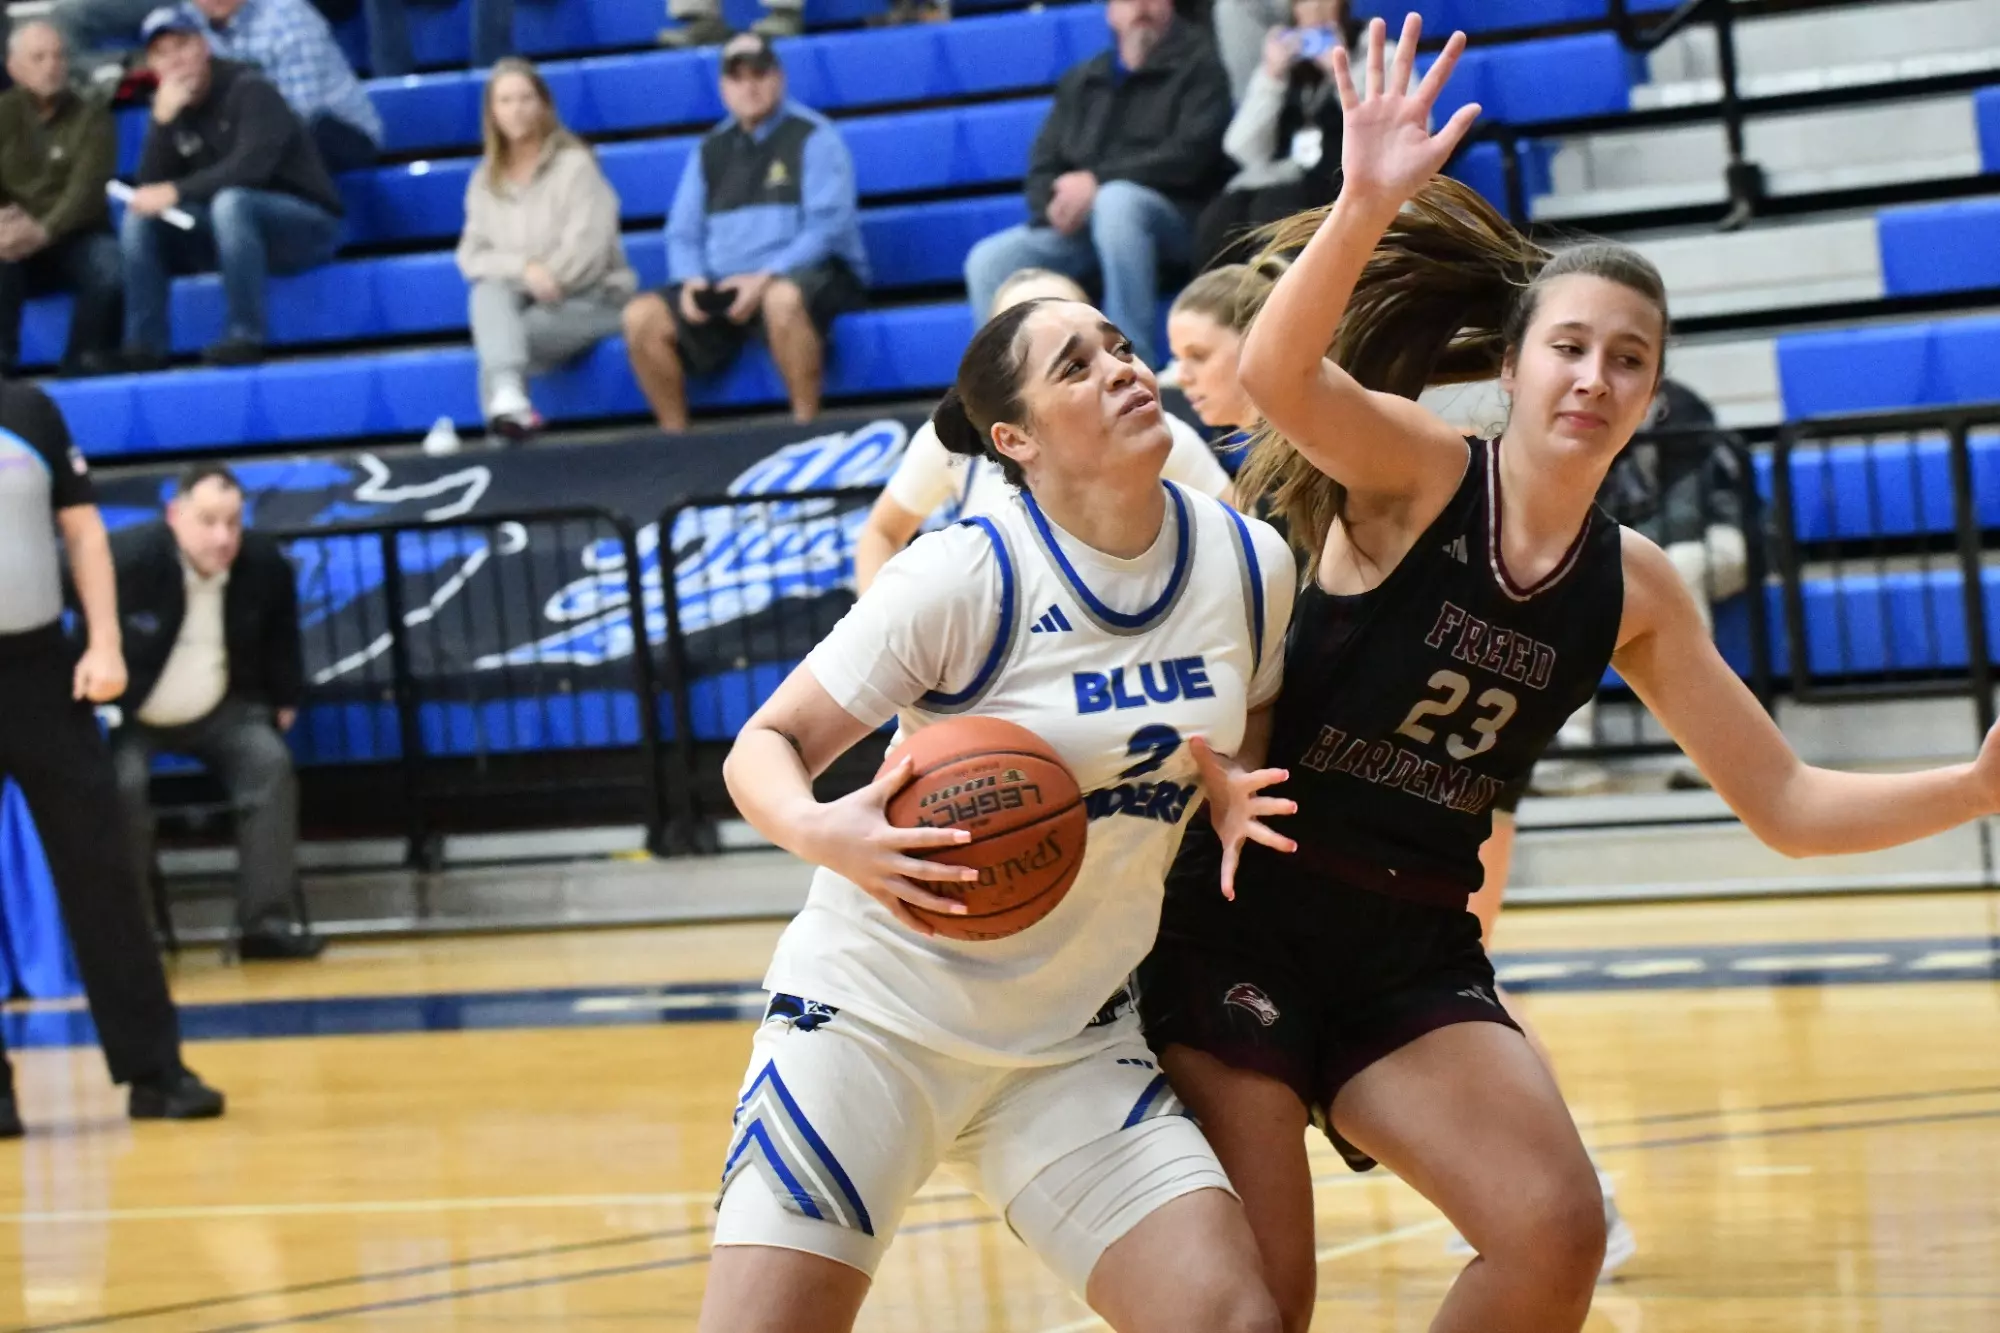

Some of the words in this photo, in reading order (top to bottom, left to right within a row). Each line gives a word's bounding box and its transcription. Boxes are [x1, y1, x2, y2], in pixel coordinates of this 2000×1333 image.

[1072, 655, 1216, 715] BLUE
[1425, 601, 1556, 690] FREED
[1119, 722, 1182, 780] 2
[1394, 669, 1517, 760] 23
[1300, 724, 1504, 815] HARDEMAN
